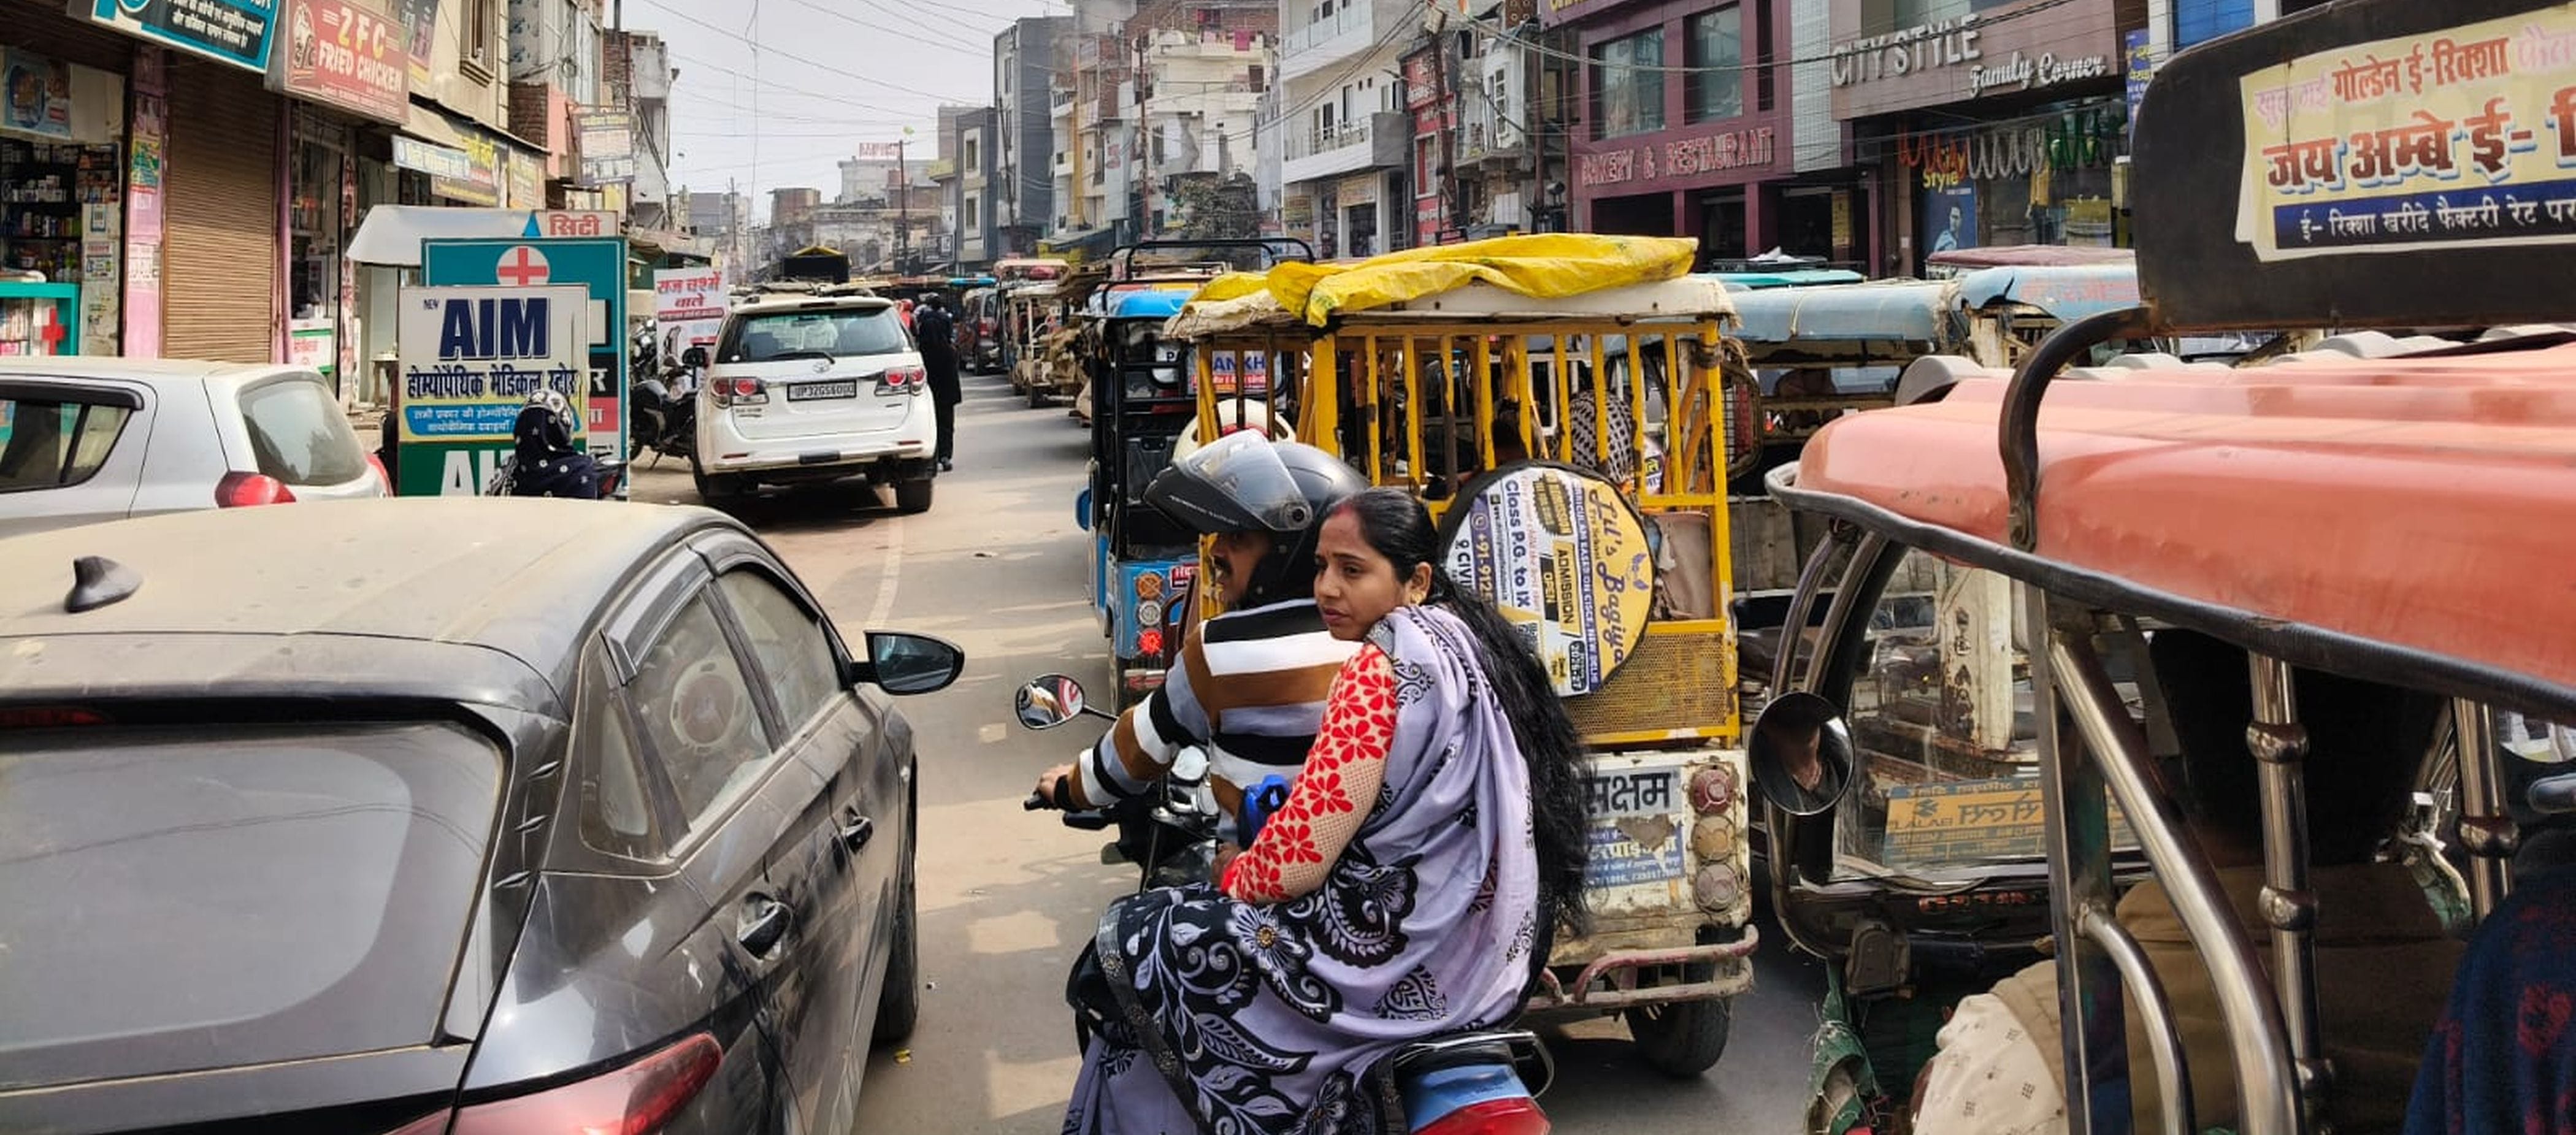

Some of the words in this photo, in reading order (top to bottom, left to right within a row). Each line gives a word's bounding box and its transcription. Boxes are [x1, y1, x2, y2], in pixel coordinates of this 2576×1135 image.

[339, 7, 353, 47] 2
[356, 14, 370, 52] F
[372, 23, 385, 59] C
[1831, 36, 1885, 86] CITY
[1893, 12, 1984, 76] STYLE
[318, 40, 355, 75] FRIED
[356, 55, 403, 92] CHICKEN
[1969, 51, 2036, 98] Family
[2039, 53, 2106, 85] Corner
[2332, 54, 2401, 102] गोल्डेन
[1581, 147, 1635, 186] BAKERY
[1665, 126, 1774, 178] RESTAURANT
[2263, 136, 2338, 188] जय
[2350, 109, 2455, 180] अम्बे
[550, 215, 601, 236] सिटी
[2329, 207, 2376, 237] रिक्शा
[2505, 194, 2538, 226] रेट
[423, 297, 439, 310] NEW
[439, 297, 550, 362] AIM
[406, 365, 485, 399] होम्योपैथिक
[489, 364, 542, 397] मेडिकल
[477, 407, 521, 419] होम्योपैथि
[1505, 480, 1522, 527] Class
[1511, 532, 1525, 562] P.G.
[1456, 554, 1472, 589] CIVI
[1514, 569, 1527, 587] to
[1543, 572, 1555, 604] OPEN
[1557, 549, 1574, 624] ADMISSION
[1516, 591, 1530, 608] IX
[1597, 562, 1626, 664] Bagiya
